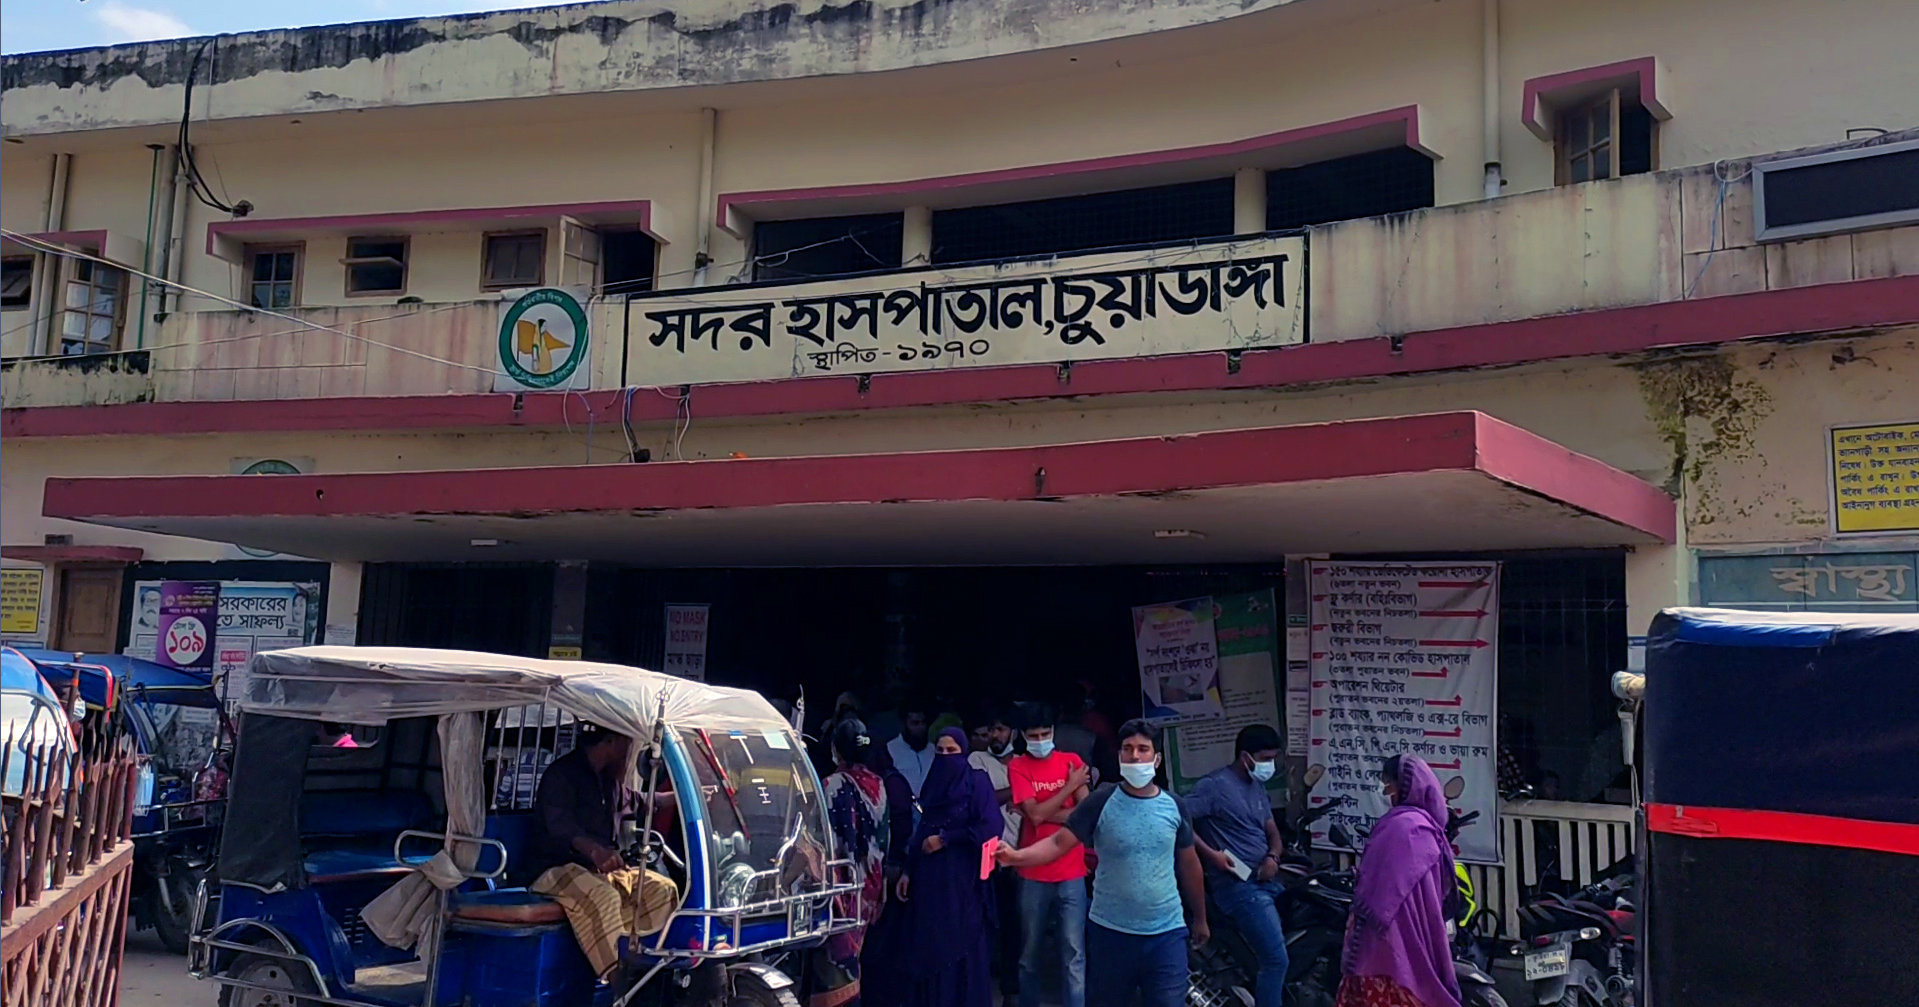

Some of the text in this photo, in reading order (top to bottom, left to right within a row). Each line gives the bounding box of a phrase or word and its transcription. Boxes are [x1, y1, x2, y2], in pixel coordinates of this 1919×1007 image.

[645, 301, 776, 353] সদর
[1053, 253, 1287, 345] চুয়াডাঙ্গা
[808, 345, 877, 370] স্থাপিত
[897, 338, 989, 362] ১৯৭০
[1769, 561, 1913, 601] স্বাস্থ্য
[239, 616, 287, 630] সাফল্য
[1357, 621, 1382, 635] বিভাগ
[169, 631, 204, 653] ১০৯
[1377, 653, 1391, 663] নন
[1393, 650, 1424, 664] কোভিড
[1427, 652, 1470, 666] হাসপাতাল
[1330, 679, 1405, 694] অপারেশন থিয়েটার
[1418, 715, 1424, 723] ও
[1462, 710, 1488, 727] বিভাগ
[1449, 745, 1469, 758] ভায়া
[1472, 746, 1489, 758] রুম
[1328, 765, 1351, 778] গাইনি
[1356, 770, 1362, 779] ও
